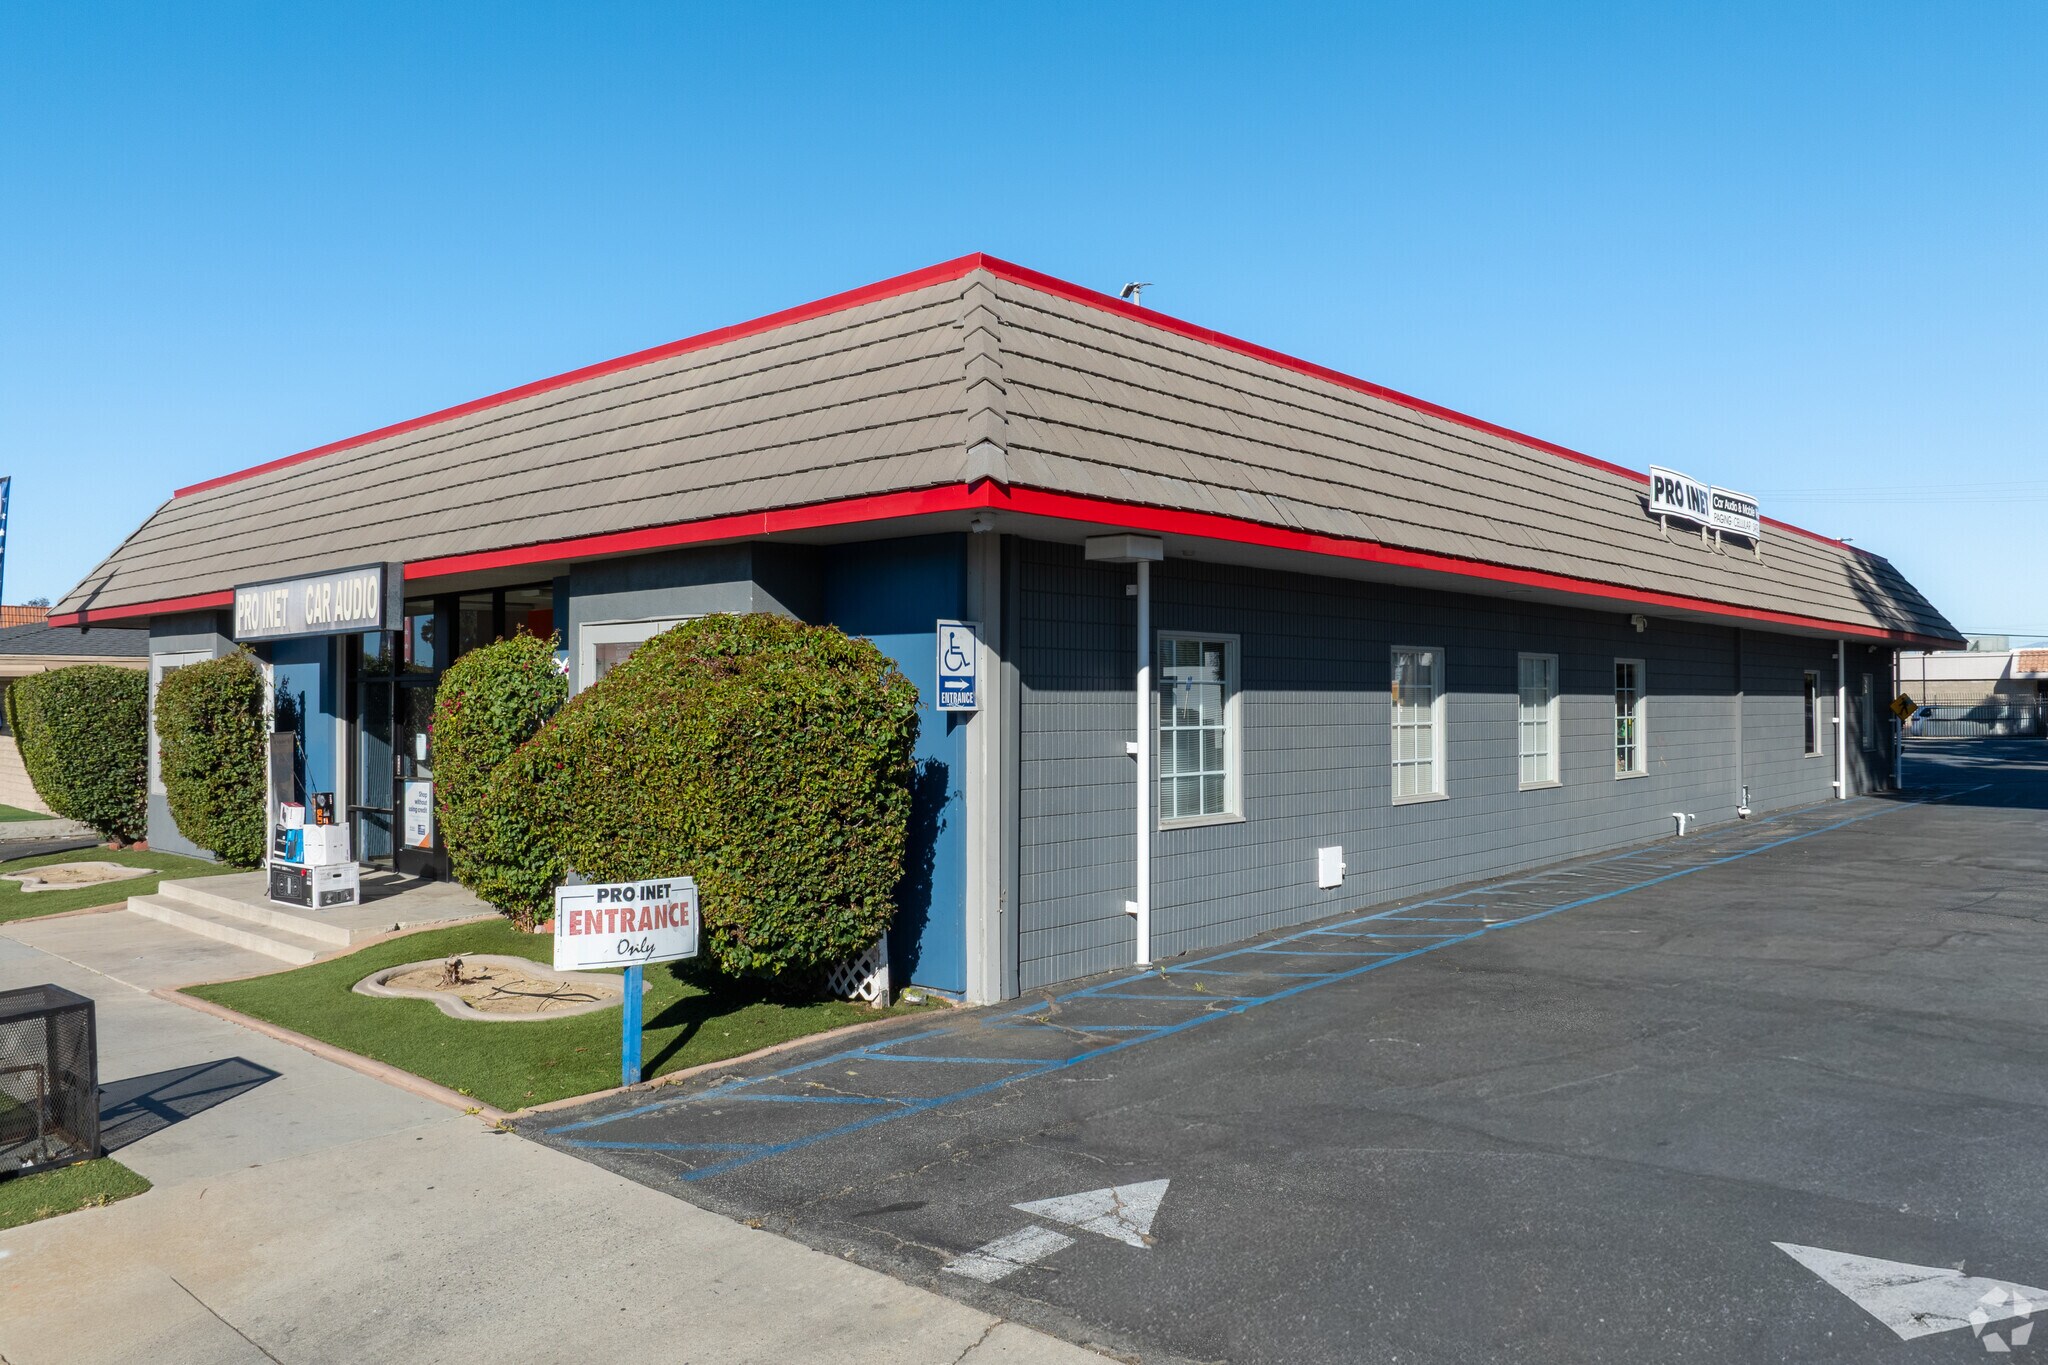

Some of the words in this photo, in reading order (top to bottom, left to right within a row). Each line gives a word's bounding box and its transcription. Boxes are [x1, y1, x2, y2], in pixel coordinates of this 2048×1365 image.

[1654, 475, 1684, 508] PRO
[1686, 484, 1709, 516] INET
[1714, 496, 1724, 509] Car
[1724, 499, 1738, 512] Audio
[1742, 503, 1755, 517] Mobile
[1714, 512, 1732, 526] PAGING
[1734, 516, 1751, 530] CELLULAR
[238, 593, 259, 631] PRO
[262, 588, 289, 629] INET
[305, 582, 331, 625] CAR
[334, 575, 378, 622] AUDIO
[941, 692, 974, 703] ENTRANCE
[597, 886, 636, 903] PRO
[640, 883, 672, 901] INET
[569, 901, 689, 936] ENTRANCE
[617, 936, 656, 961] Only
